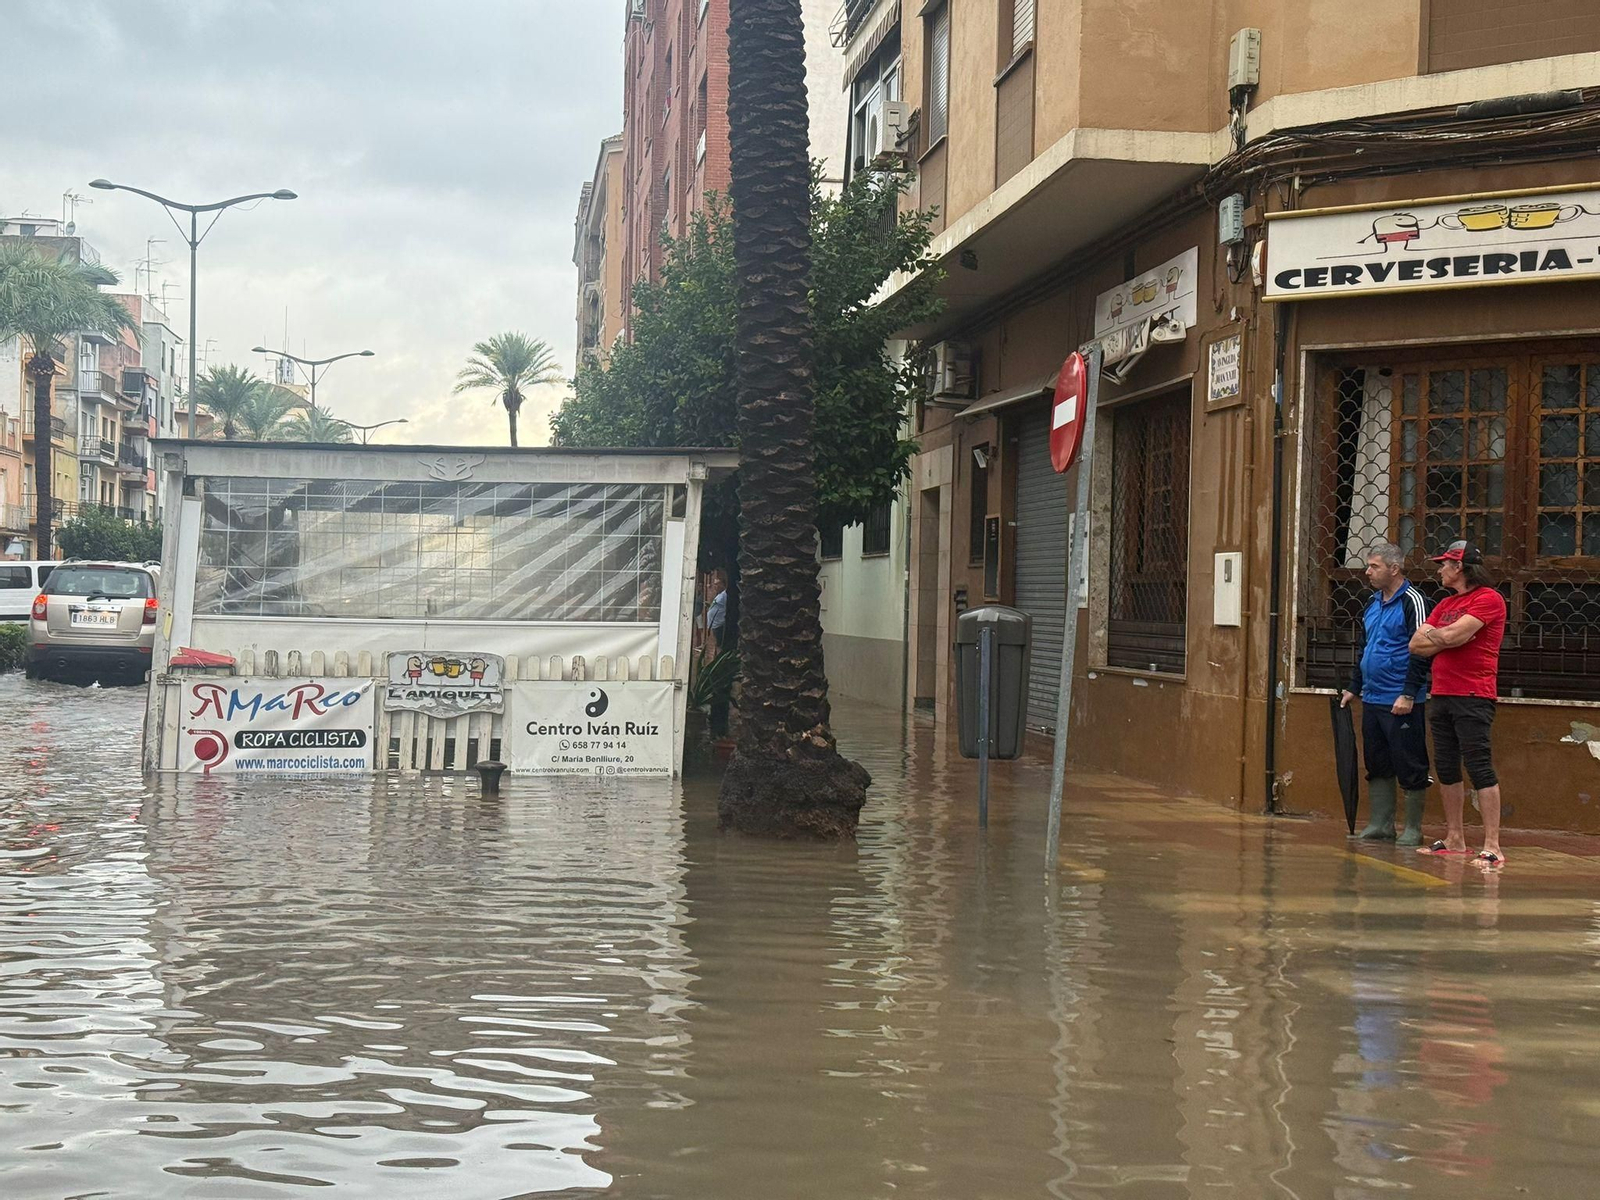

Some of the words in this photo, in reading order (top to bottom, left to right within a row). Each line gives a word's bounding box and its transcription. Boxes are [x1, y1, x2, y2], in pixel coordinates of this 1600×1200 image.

[79, 614, 98, 623] 1863
[526, 721, 583, 735] Centro
[587, 721, 620, 735] Iván
[625, 721, 659, 735] Ruíz
[242, 732, 287, 747] ROPA
[289, 731, 360, 746] CICLISTA
[572, 741, 588, 749] 658
[590, 741, 601, 749] 77
[603, 741, 614, 749] 94
[616, 741, 626, 749] 14
[235, 756, 365, 769] www.marcociclista.com
[551, 755, 560, 763] C/
[625, 755, 635, 763] 20
